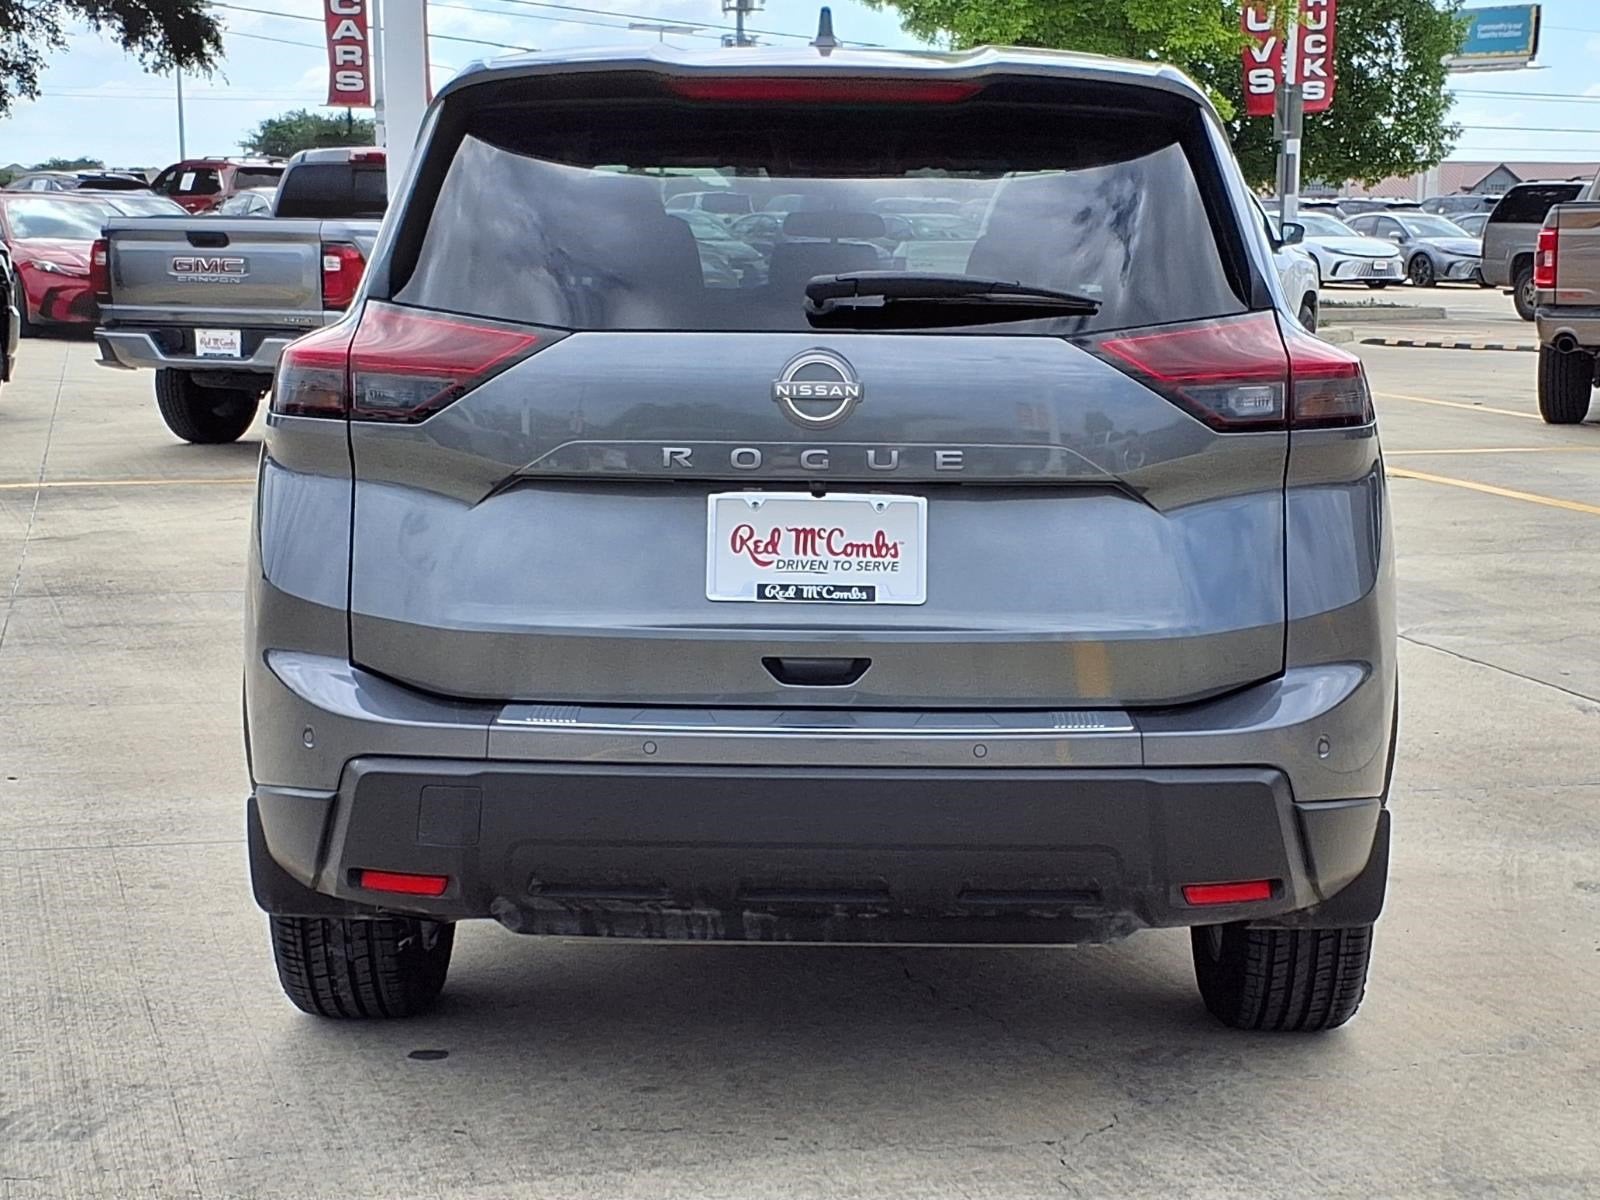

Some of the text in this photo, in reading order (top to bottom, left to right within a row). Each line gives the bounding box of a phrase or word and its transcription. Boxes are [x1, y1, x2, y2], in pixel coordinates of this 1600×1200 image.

[330, 0, 364, 91] CARS
[172, 257, 245, 273] GMC
[177, 276, 241, 284] CANYON
[776, 385, 859, 396] NISSAN
[662, 447, 964, 471] ROGUE
[731, 524, 900, 567] Red McCombs
[776, 559, 899, 572] DRIVEN TO SERVE
[765, 585, 867, 600] Red McCombs
